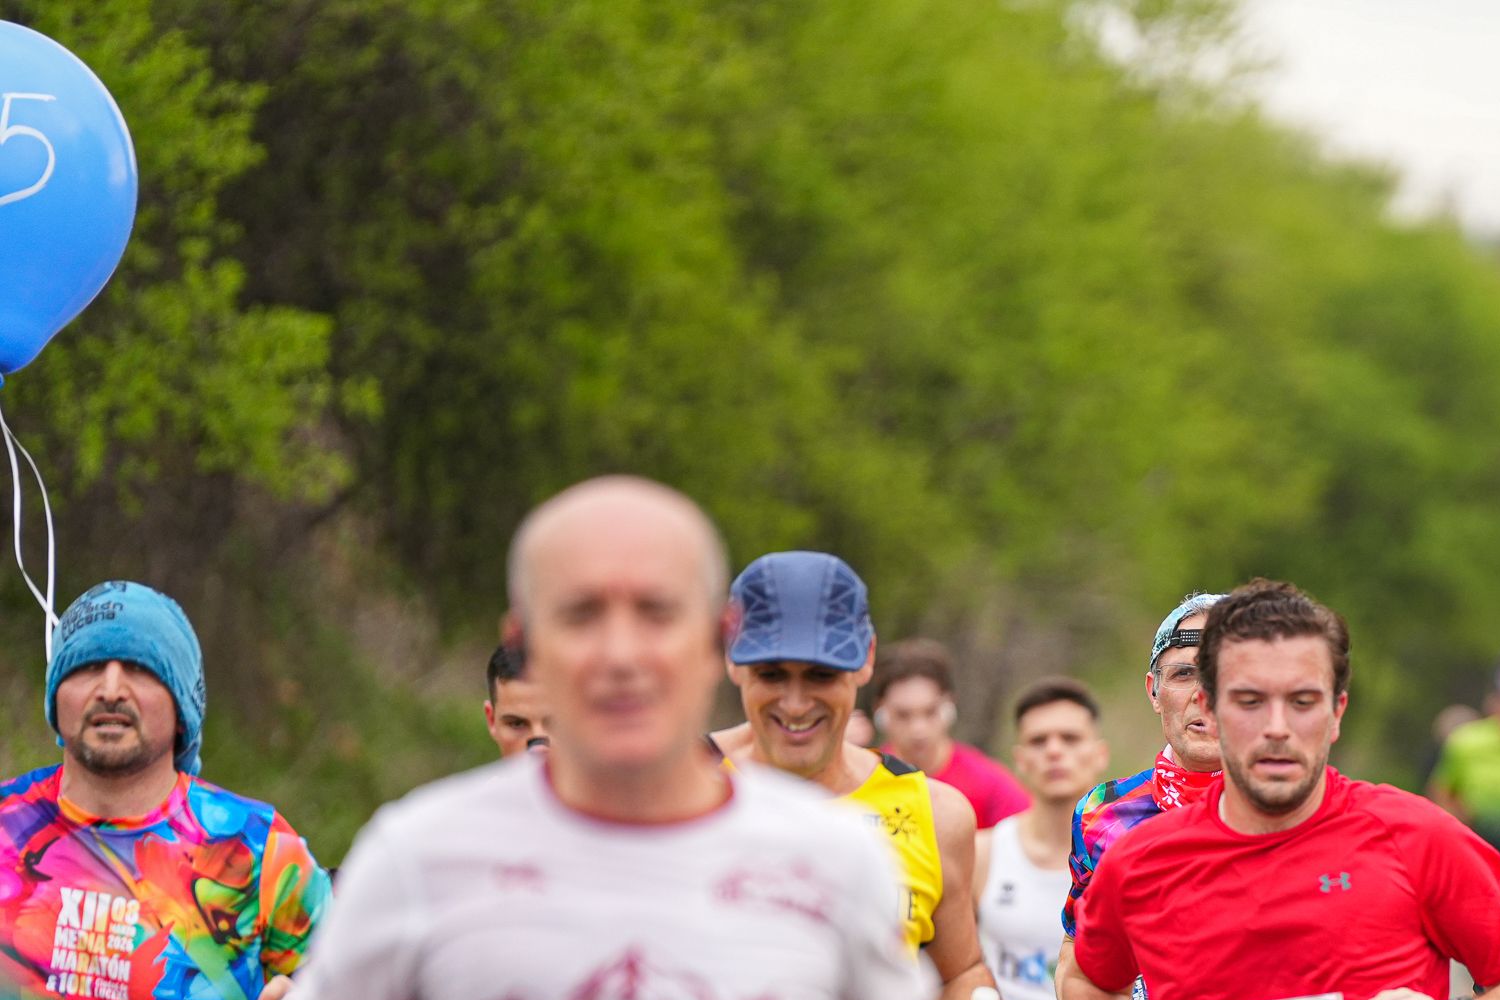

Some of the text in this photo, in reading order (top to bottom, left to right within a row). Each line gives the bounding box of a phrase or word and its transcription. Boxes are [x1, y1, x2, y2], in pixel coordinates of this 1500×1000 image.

[57, 887, 112, 933] XII
[110, 896, 140, 926] 08
[53, 926, 107, 955] MEDIA
[49, 946, 131, 983] MARATÓN
